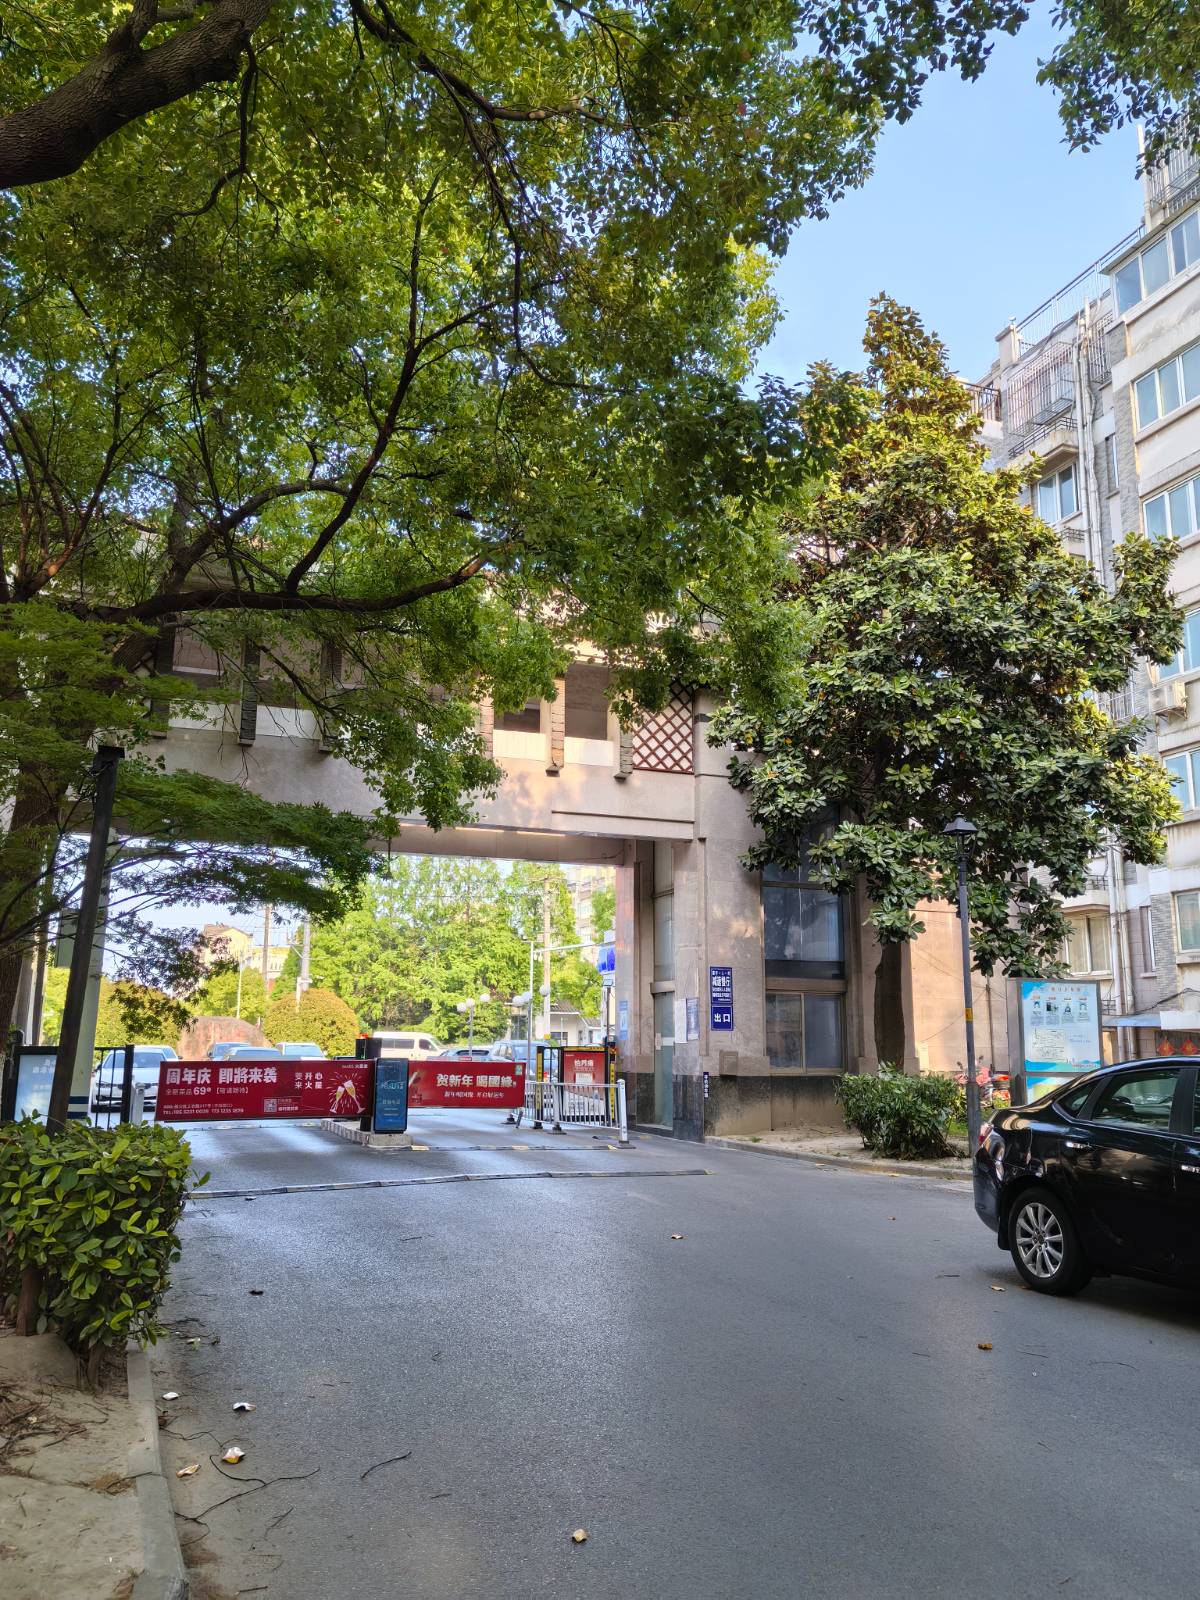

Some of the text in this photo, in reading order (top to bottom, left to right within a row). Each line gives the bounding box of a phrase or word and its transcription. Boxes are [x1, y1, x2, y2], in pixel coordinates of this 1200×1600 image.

[714, 1013, 730, 1023] 出口
[166, 1067, 212, 1085] 周年庆
[436, 1073, 474, 1088] 贺新年
